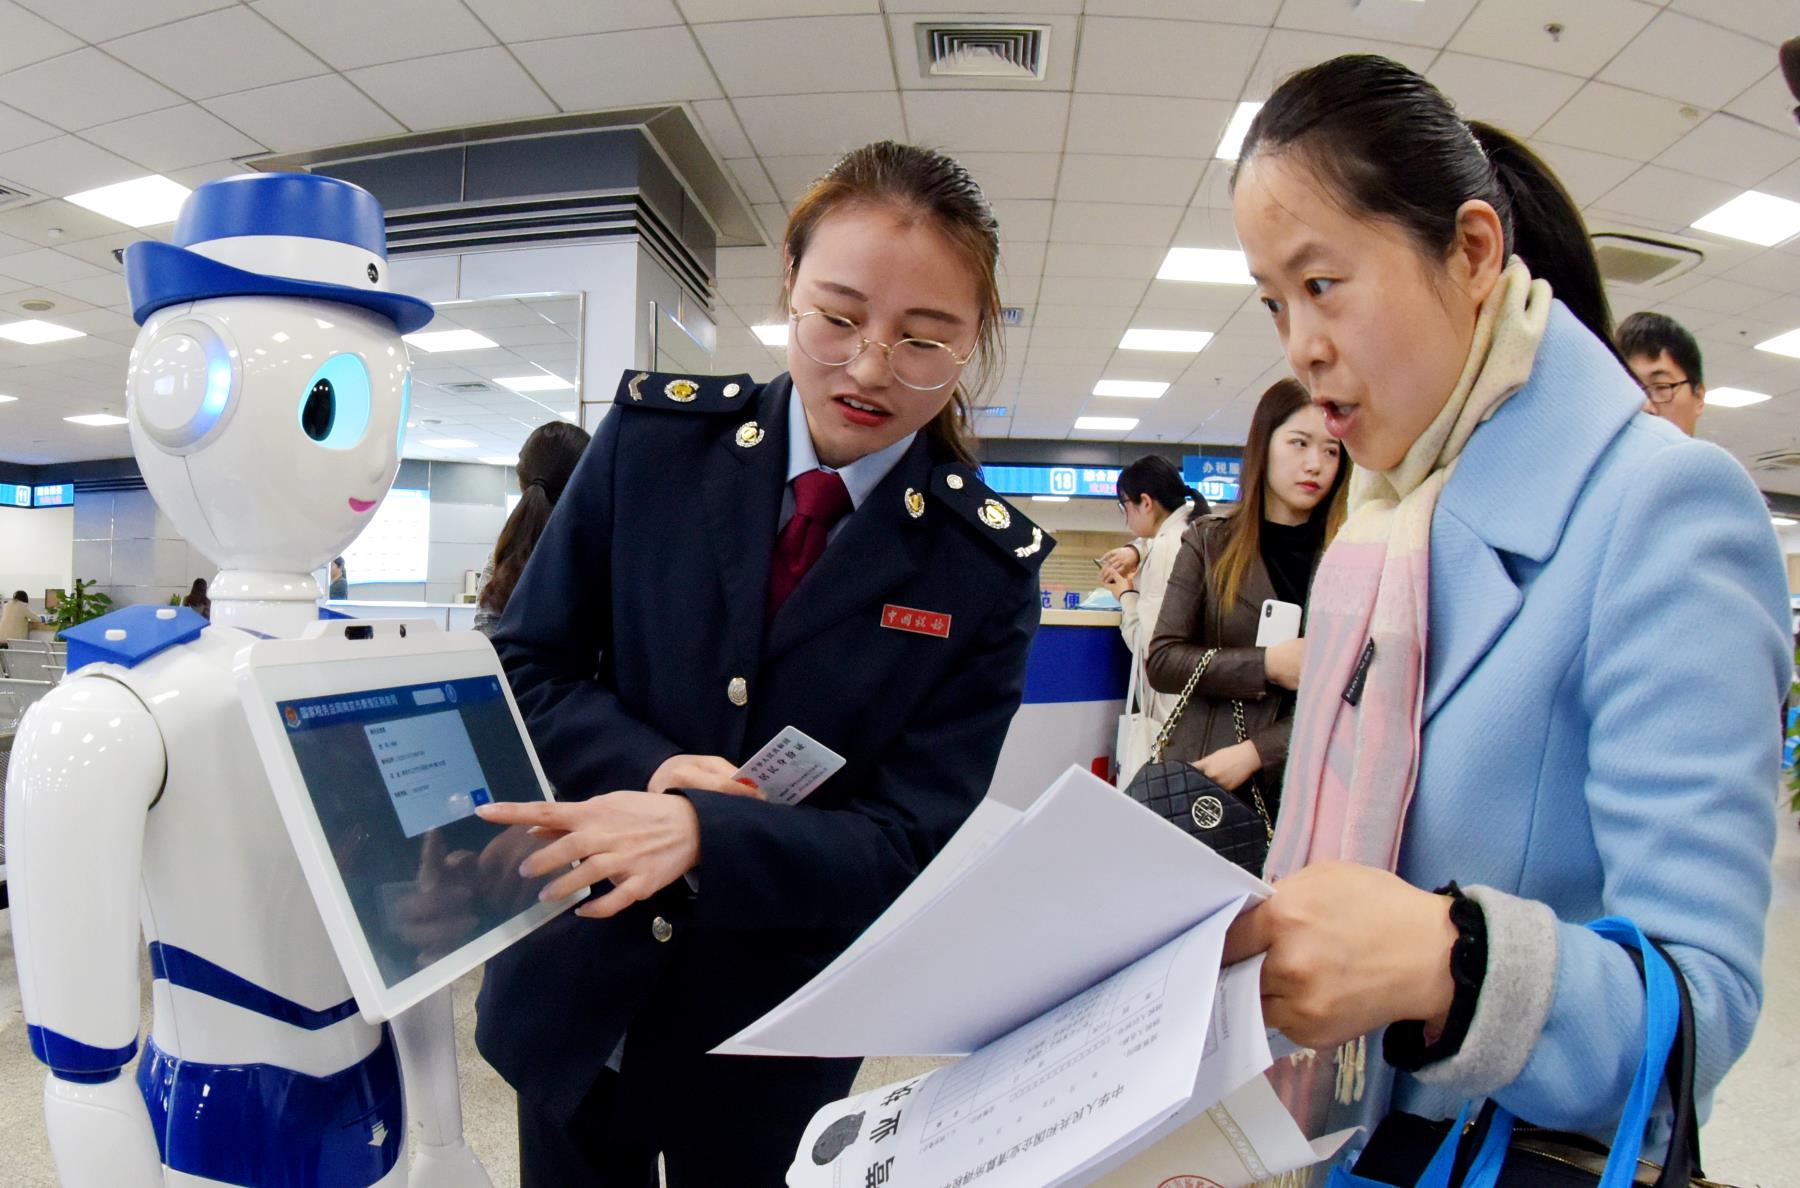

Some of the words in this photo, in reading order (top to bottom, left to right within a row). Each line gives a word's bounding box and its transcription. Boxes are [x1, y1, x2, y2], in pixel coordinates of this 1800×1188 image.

[1055, 473, 1072, 490] 18
[758, 741, 806, 783] 居民身份证
